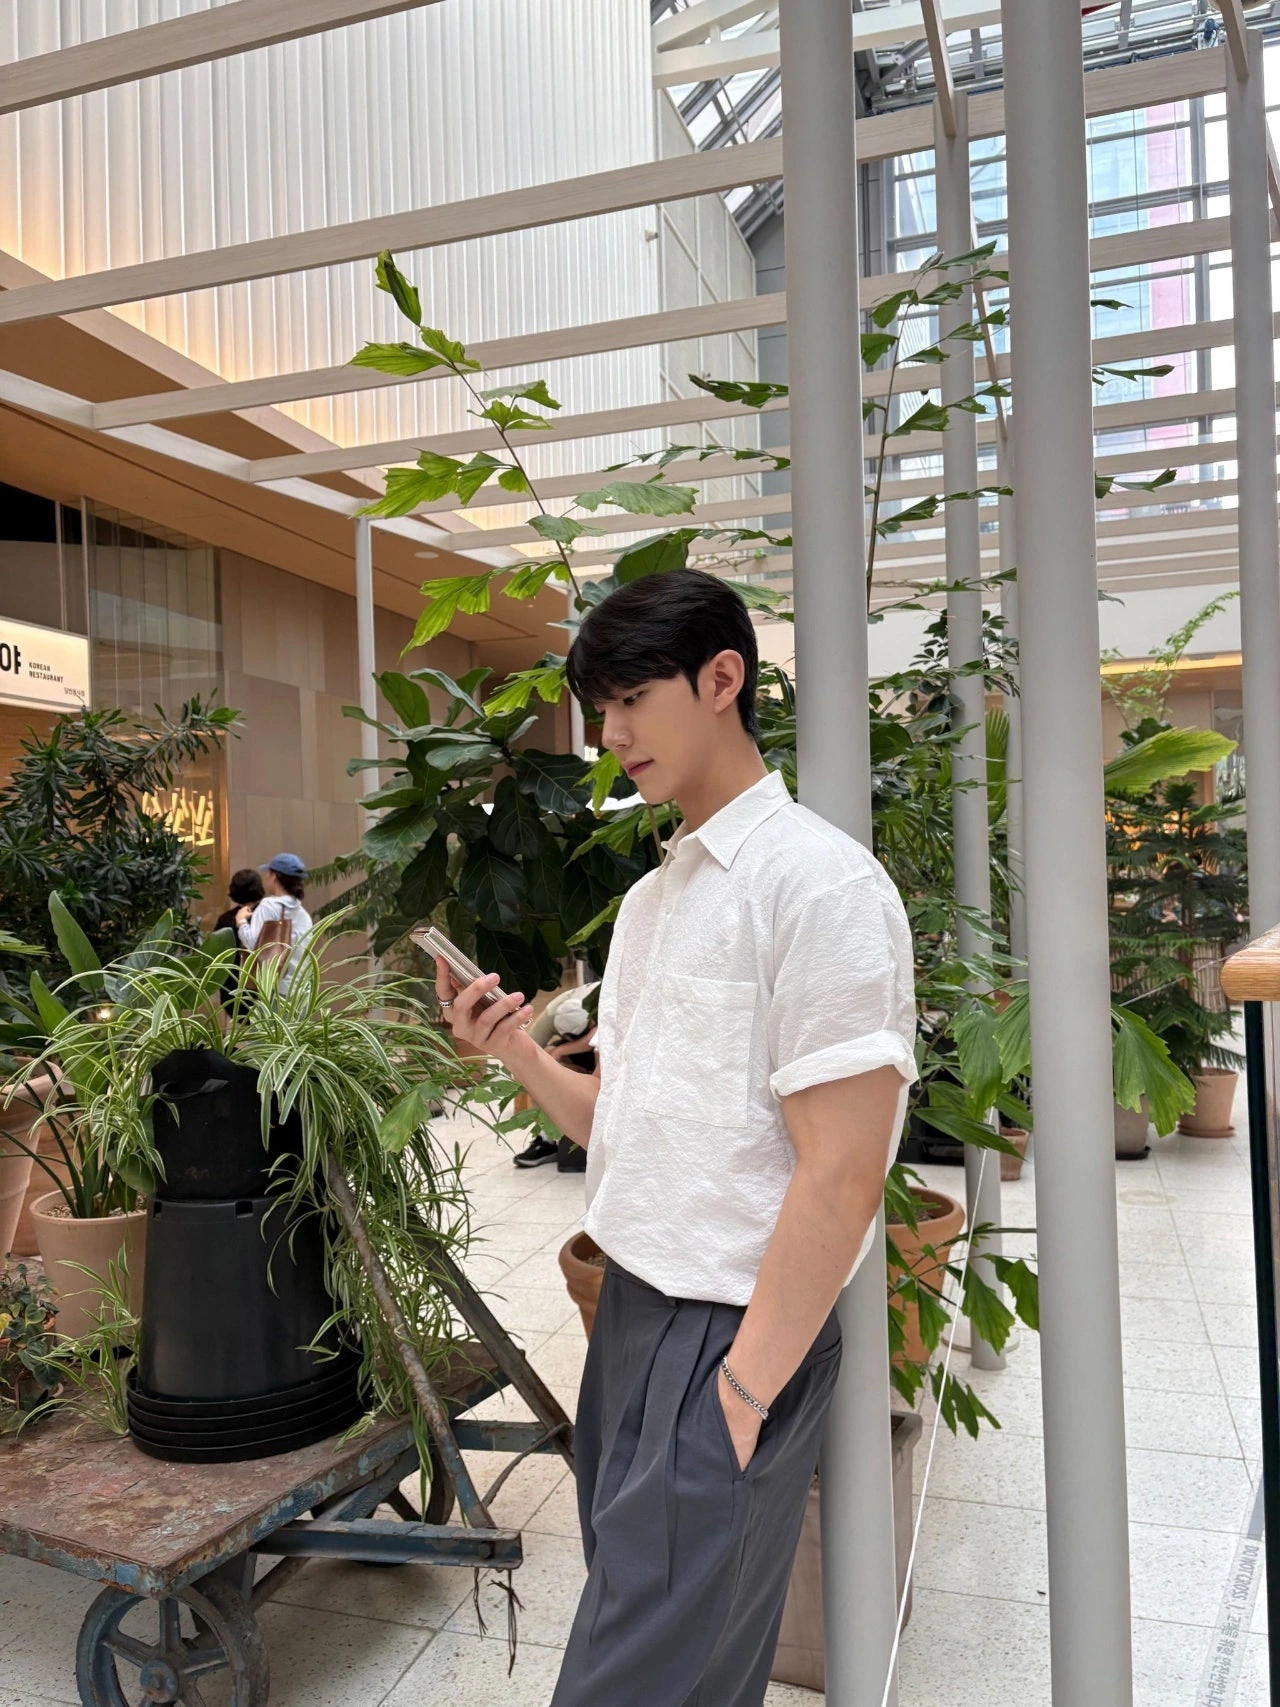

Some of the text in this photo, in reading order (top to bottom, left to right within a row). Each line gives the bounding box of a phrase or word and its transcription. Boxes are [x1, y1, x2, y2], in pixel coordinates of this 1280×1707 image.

[29, 661, 51, 672] KOREAN
[29, 671, 63, 683] RESTAURANT
[1231, 1545, 1259, 1601] DO NOT CROSS
[1216, 1638, 1236, 1656] 위한
